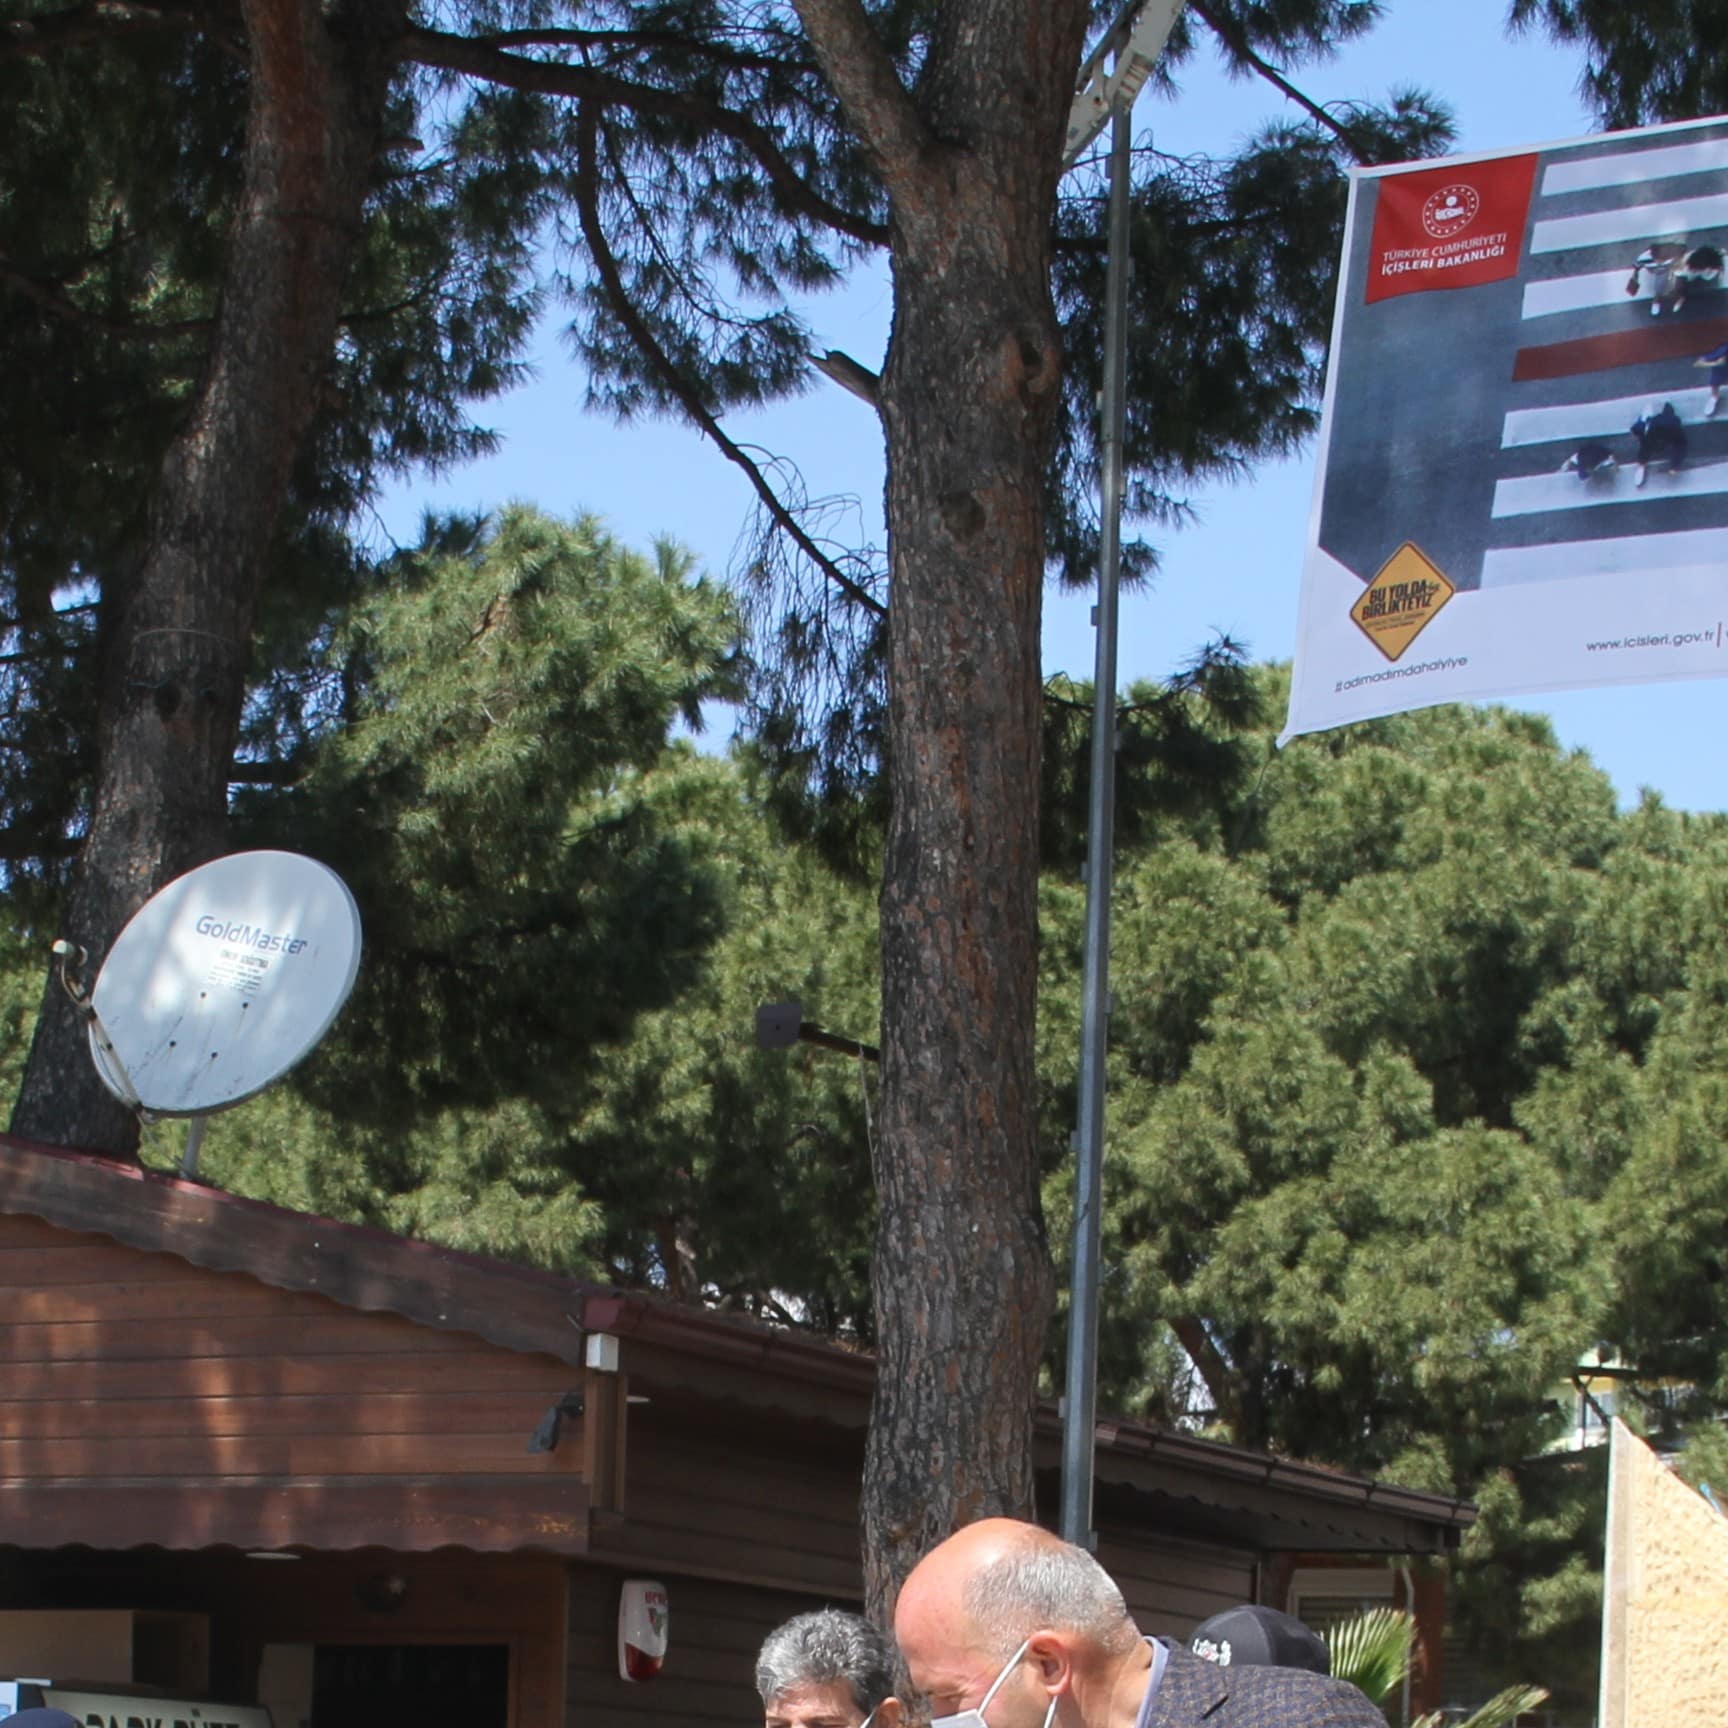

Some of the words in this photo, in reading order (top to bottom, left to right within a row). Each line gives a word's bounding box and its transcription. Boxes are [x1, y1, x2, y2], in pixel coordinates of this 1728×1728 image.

[1383, 246, 1429, 262] TÜRKİYE
[1436, 245, 1505, 269] BAKANLIĞI
[1369, 586, 1387, 605] BU
[1389, 578, 1427, 599] YOLDA
[1585, 629, 1715, 653] www.icisleri.gov.tr
[195, 914, 308, 956] GoldMaster
